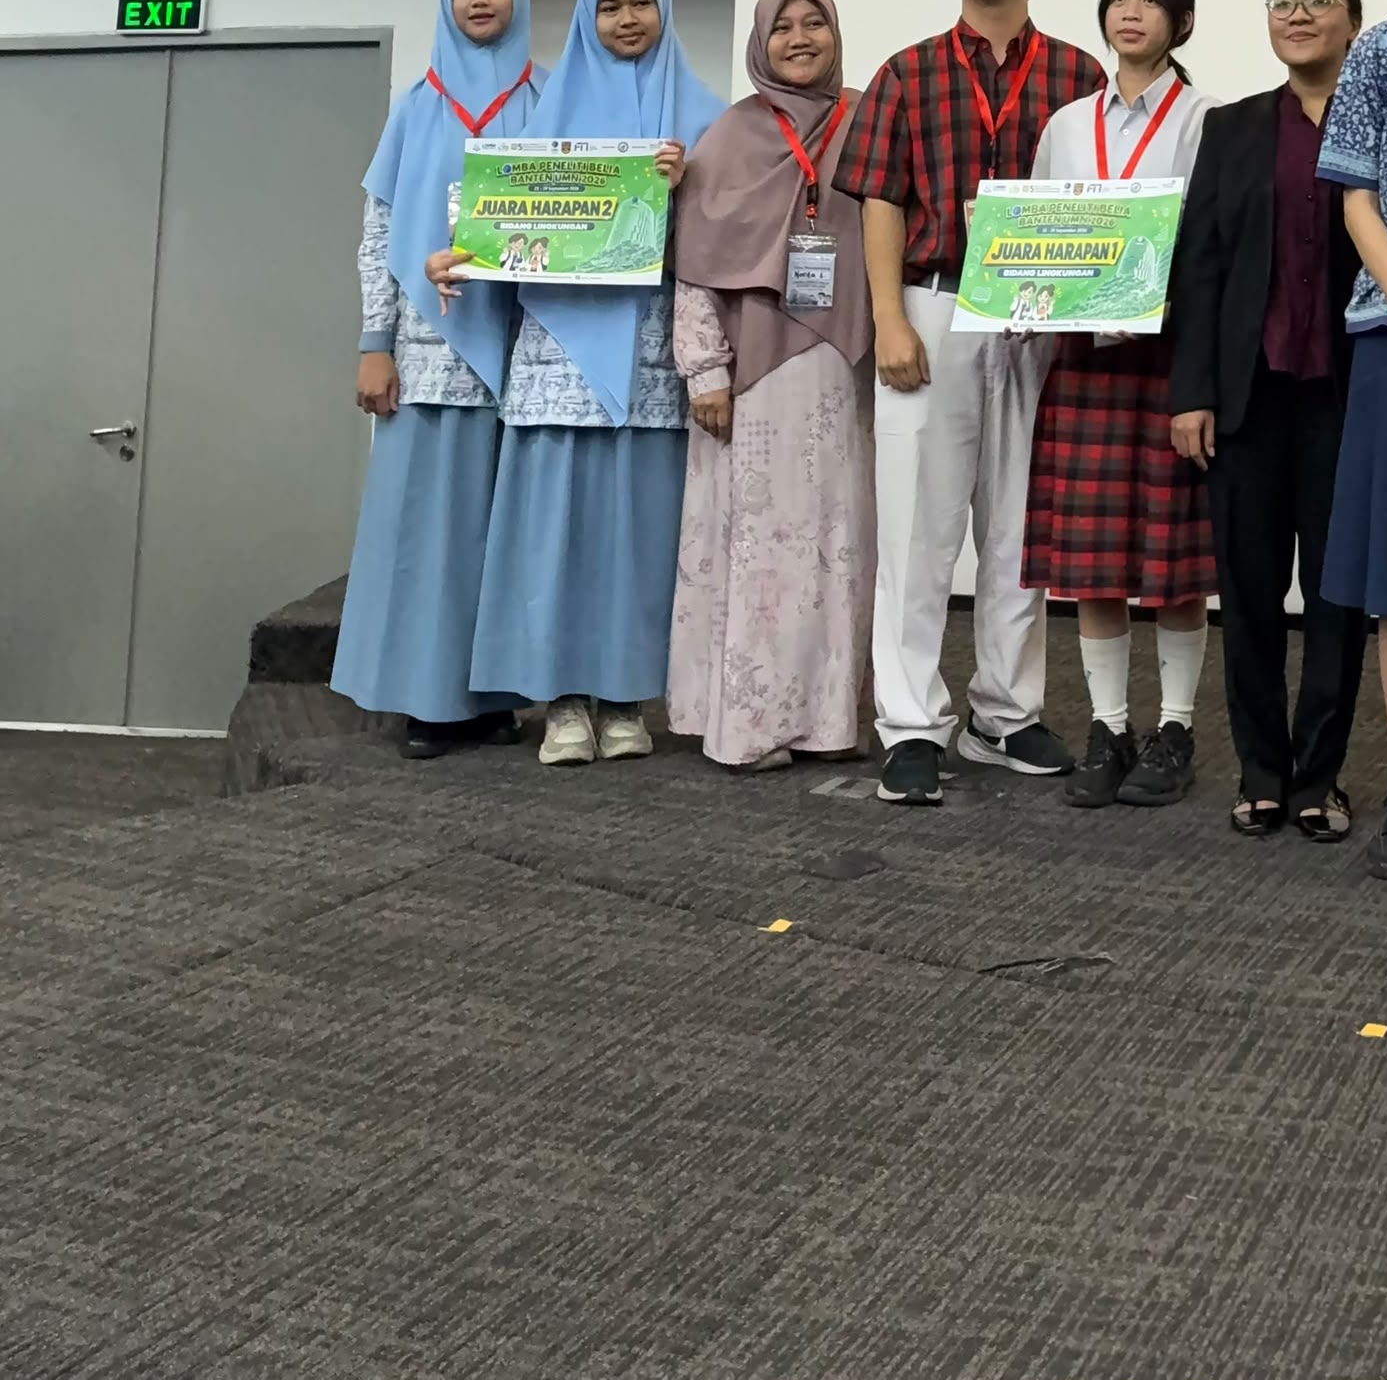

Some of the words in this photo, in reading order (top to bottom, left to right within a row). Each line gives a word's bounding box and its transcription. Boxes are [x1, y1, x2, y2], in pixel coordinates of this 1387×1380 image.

[125, 2, 193, 26] EXIT
[539, 161, 587, 172] PENELITI
[587, 161, 621, 175] BELIA
[510, 173, 554, 185] BANTEN
[555, 173, 581, 184] UMN
[581, 174, 607, 185] 2026
[476, 200, 527, 216] JUARA
[531, 200, 602, 217] HARAPAN
[602, 199, 613, 217] 2
[1049, 202, 1100, 214] PENELITI
[1100, 203, 1131, 217] BELIA
[500, 222, 532, 231] BIDANG
[533, 222, 588, 231] LINGKUNGAN
[1018, 215, 1064, 227] BANTEN
[1063, 214, 1090, 225] UMN
[991, 242, 1042, 261] JUARA
[1044, 242, 1110, 261] HARAPAN
[1109, 241, 1119, 260] 1
[1003, 268, 1036, 277] BIDANG
[1037, 268, 1094, 277] LINGKUNGAN
